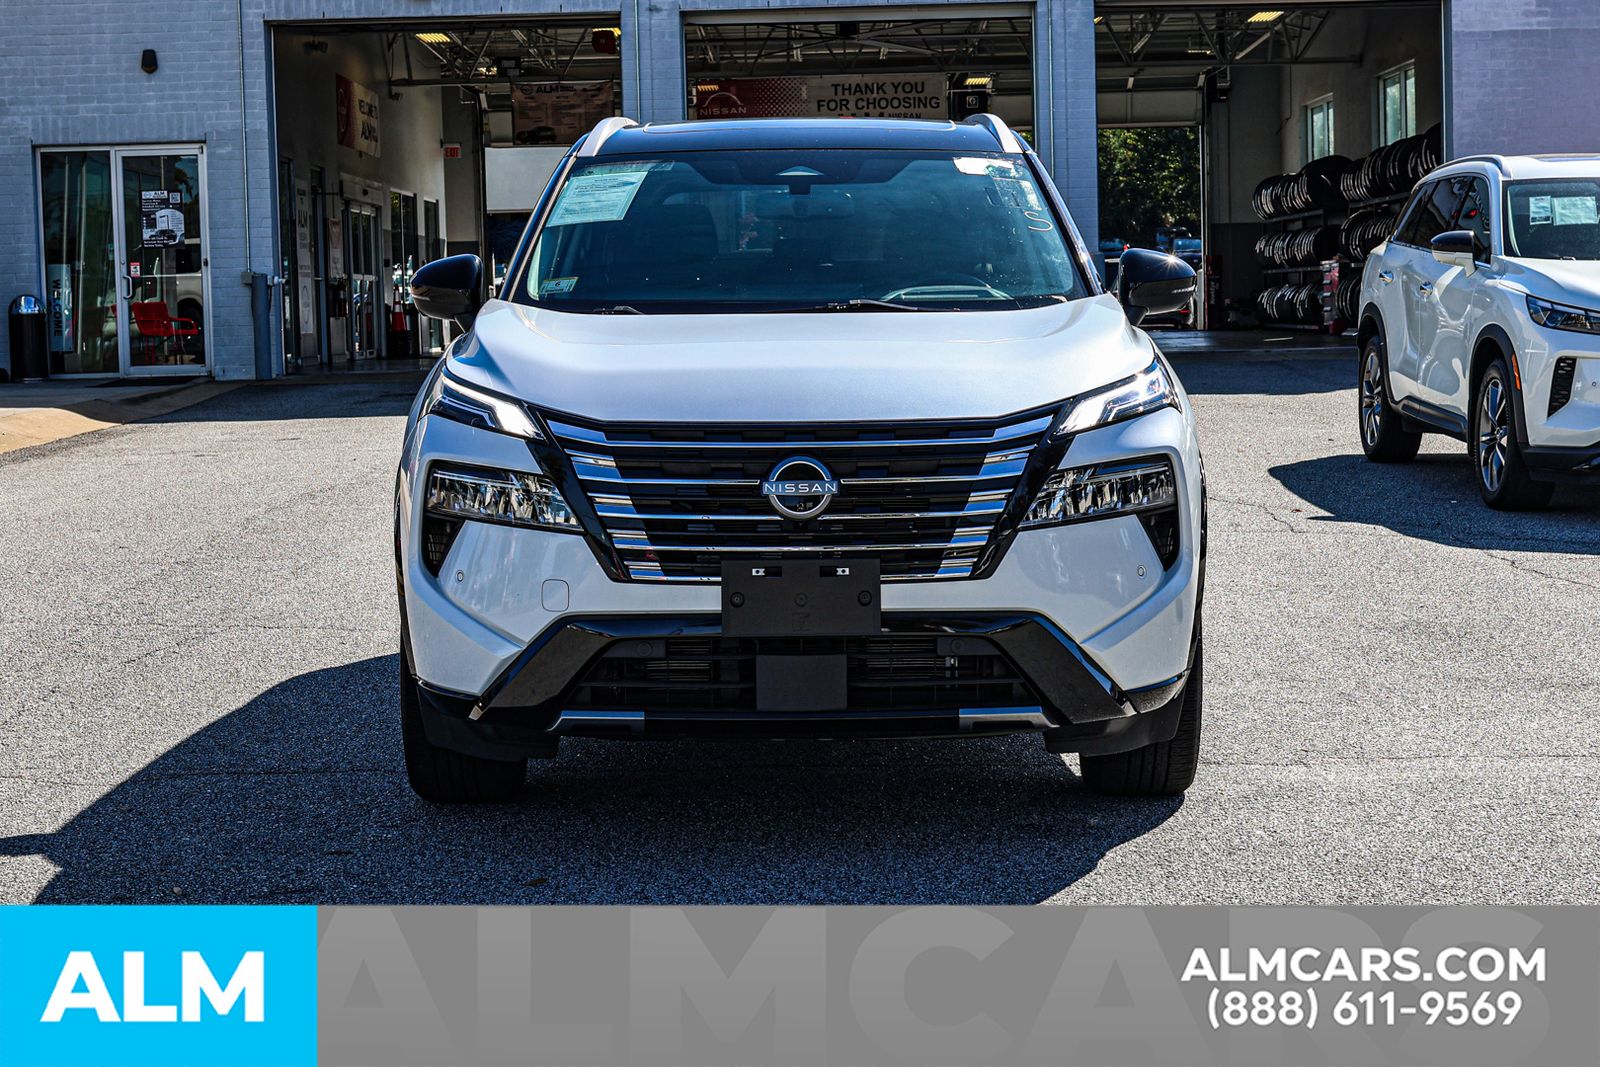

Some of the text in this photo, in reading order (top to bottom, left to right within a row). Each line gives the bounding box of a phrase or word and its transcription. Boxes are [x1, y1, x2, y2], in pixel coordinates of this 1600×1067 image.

[536, 85, 560, 93] ALM
[831, 81, 926, 96] THANK YOU
[817, 95, 941, 112] FOR CHOOSING
[699, 106, 747, 116] NISSAN
[764, 483, 836, 493] NISSAN
